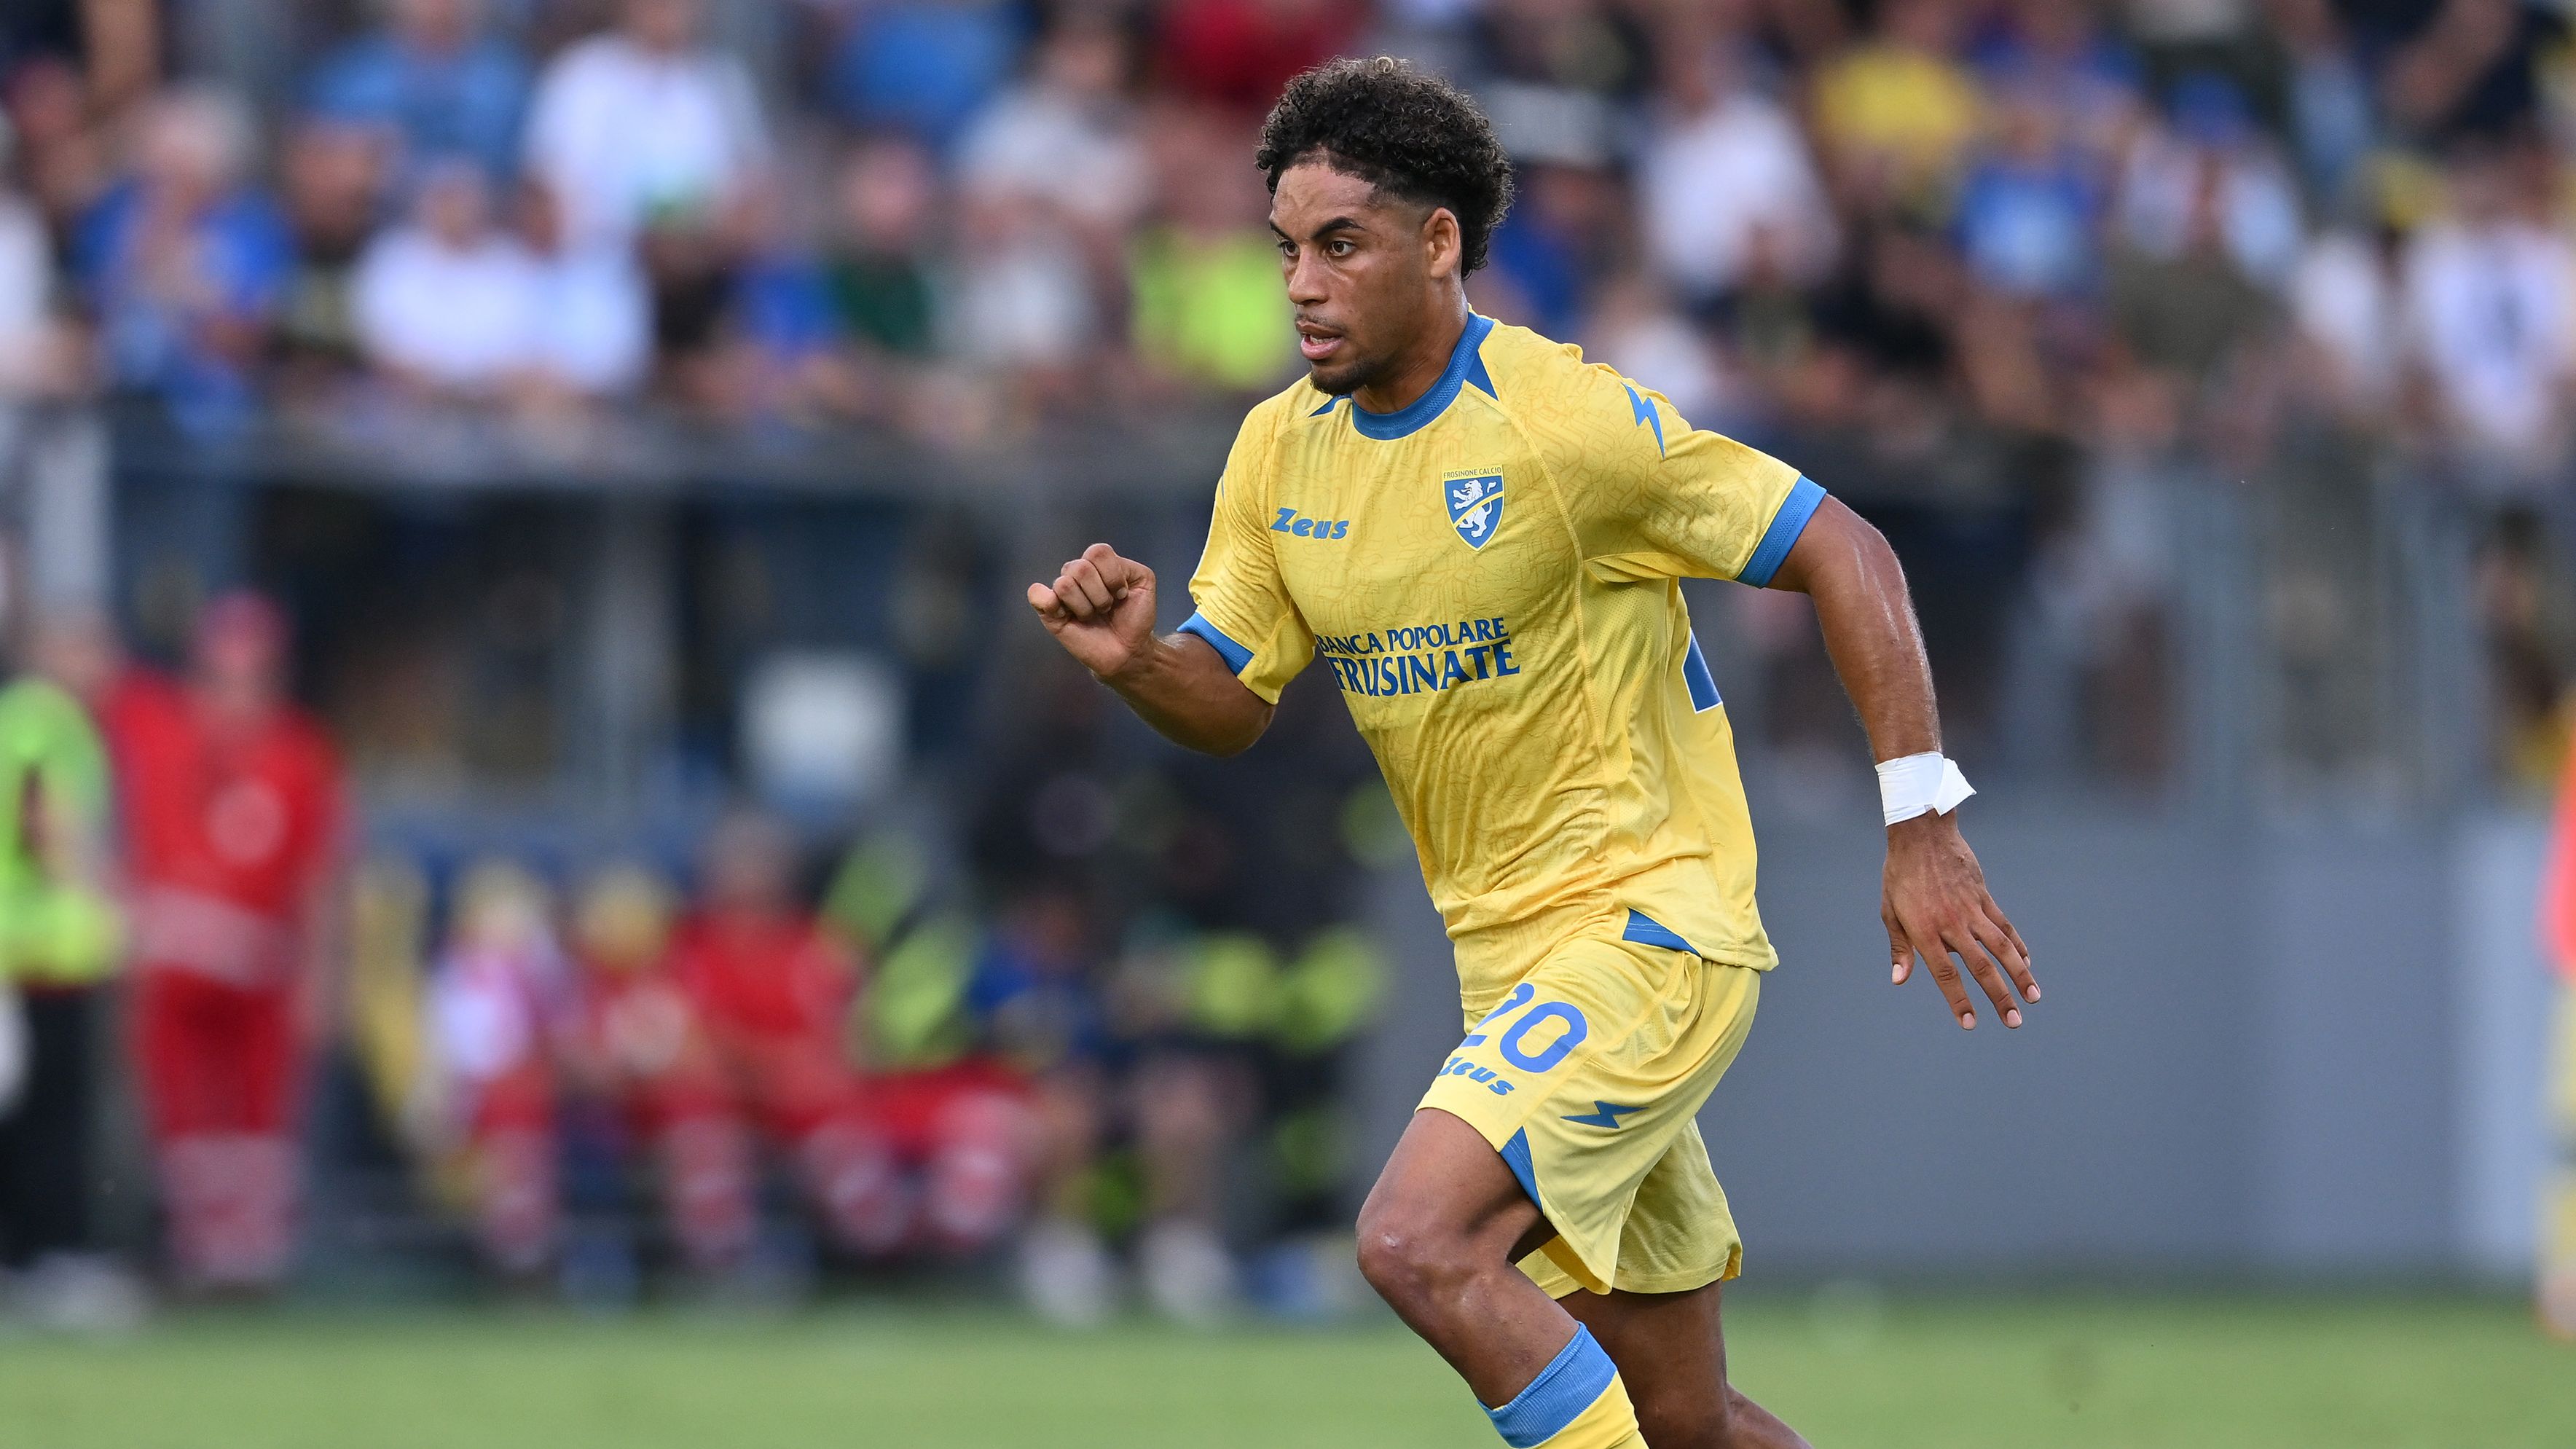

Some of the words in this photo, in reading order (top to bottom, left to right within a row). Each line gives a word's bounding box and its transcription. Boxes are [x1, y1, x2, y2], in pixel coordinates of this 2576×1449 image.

[1443, 469, 1477, 478] FROSINONE
[1479, 467, 1501, 475] CALCIO
[1270, 507, 1349, 539] Zeus
[1315, 632, 1385, 655] BANCA
[1386, 617, 1509, 652] POPOLARE
[1325, 639, 1520, 696] FRUSINATE
